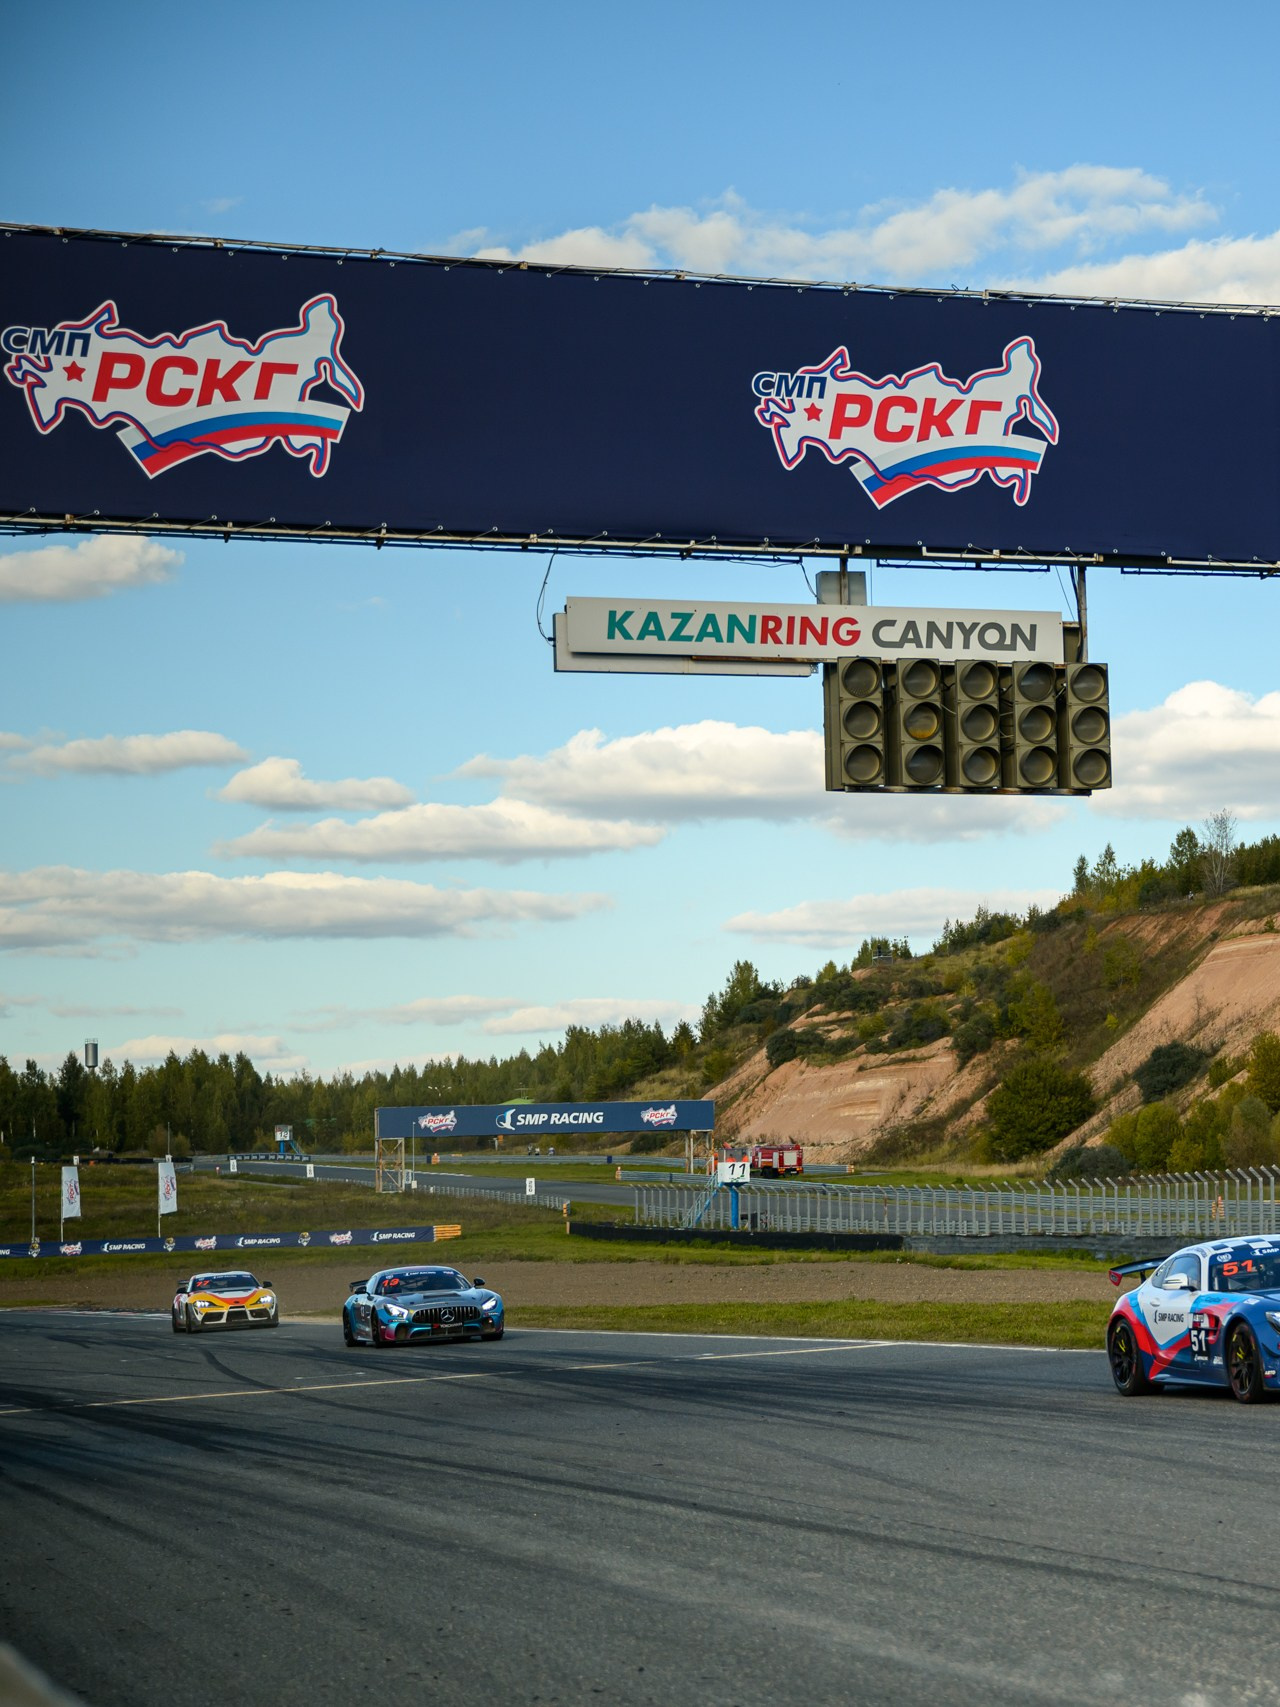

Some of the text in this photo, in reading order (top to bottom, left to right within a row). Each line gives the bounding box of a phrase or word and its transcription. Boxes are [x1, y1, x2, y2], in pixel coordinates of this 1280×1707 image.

[2, 327, 91, 357] СМП
[92, 352, 299, 408] РСКГ
[753, 372, 827, 399] СМП
[829, 394, 1003, 443] РСКГ
[606, 610, 1038, 652] KAZANRING CANYON
[516, 1112, 604, 1125] SMP RACING
[728, 1163, 746, 1176] 11
[257, 1237, 281, 1245] RACING
[391, 1231, 416, 1239] RACING
[1222, 1260, 1254, 1277] 51
[382, 1278, 400, 1287] 13
[1158, 1313, 1168, 1322] SMP
[1168, 1312, 1184, 1323] RACING
[1190, 1329, 1207, 1352] 51
